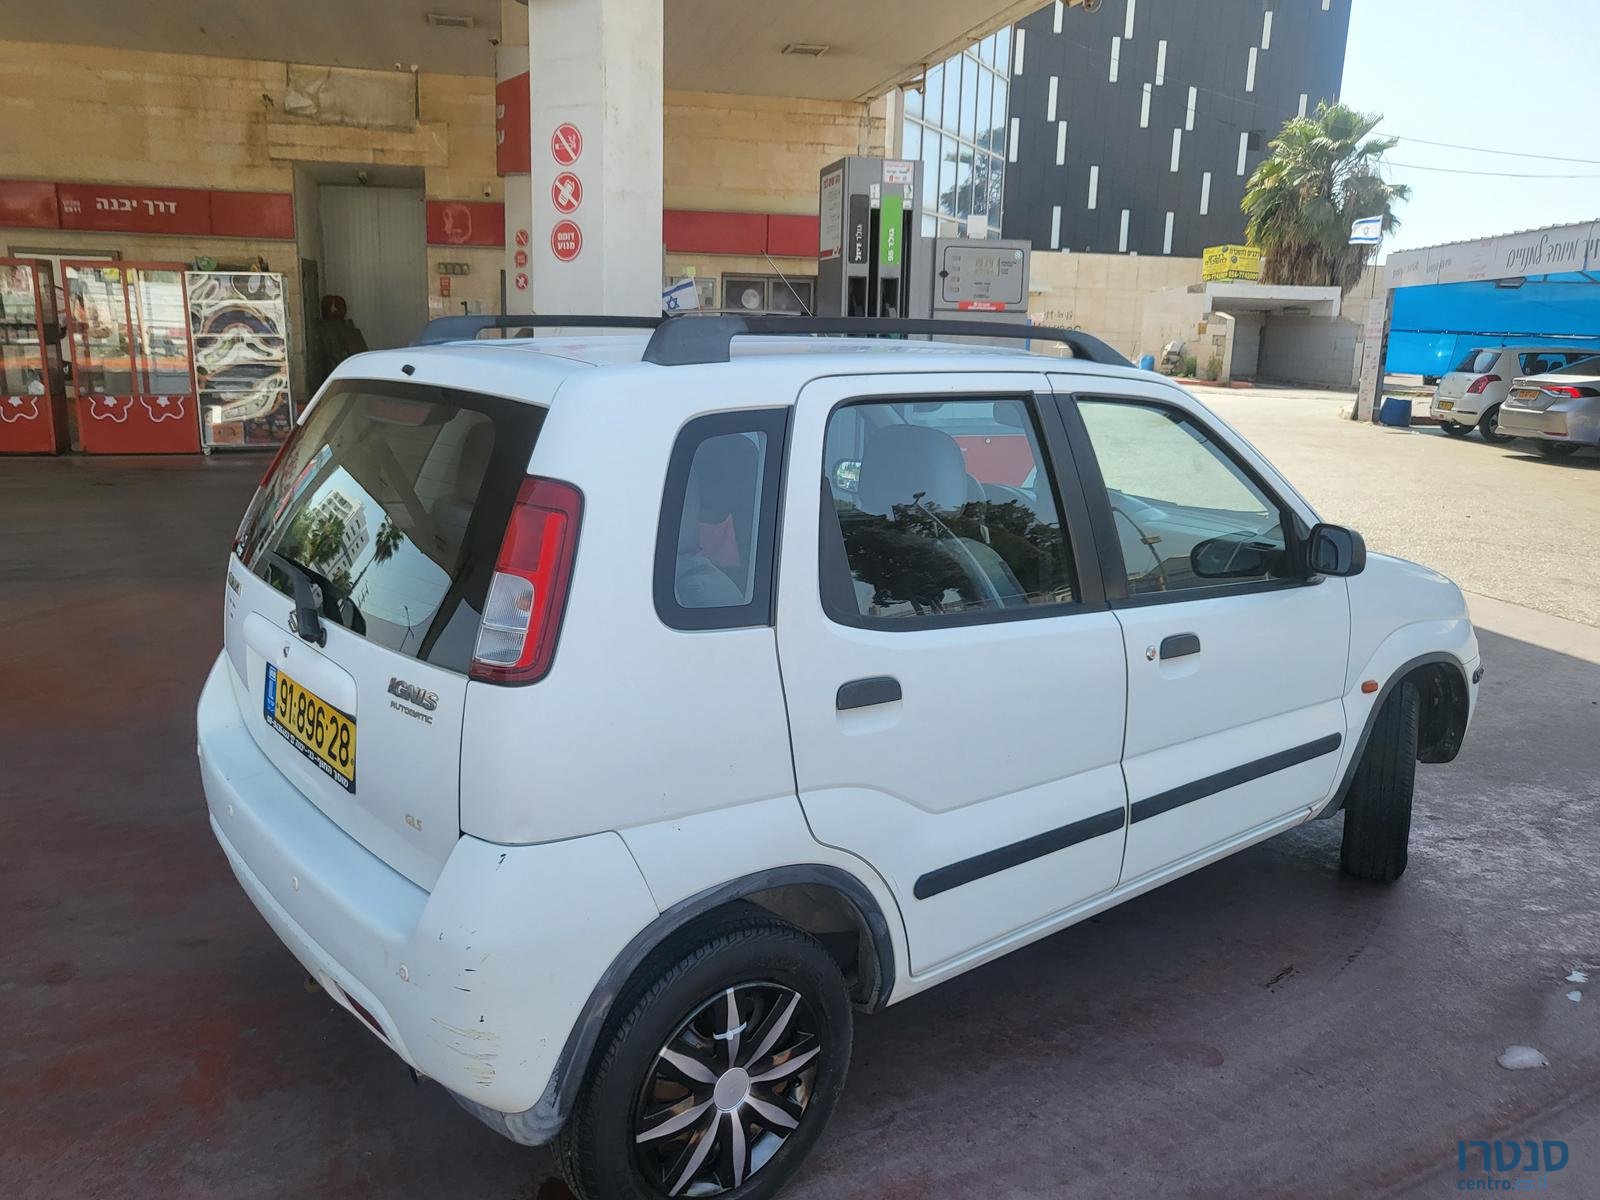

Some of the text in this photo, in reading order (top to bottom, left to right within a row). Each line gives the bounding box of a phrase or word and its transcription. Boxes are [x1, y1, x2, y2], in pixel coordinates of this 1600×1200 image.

[95, 196, 139, 212] יבנה
[143, 199, 178, 216] דרך
[557, 232, 575, 241] דומם
[557, 241, 576, 250] מנוע
[1505, 233, 1549, 273] למנויים
[1546, 238, 1580, 263] מיוחד
[387, 677, 439, 712] IGNIS
[389, 700, 434, 725] AUTOMATIC
[404, 813, 423, 833] GLS
